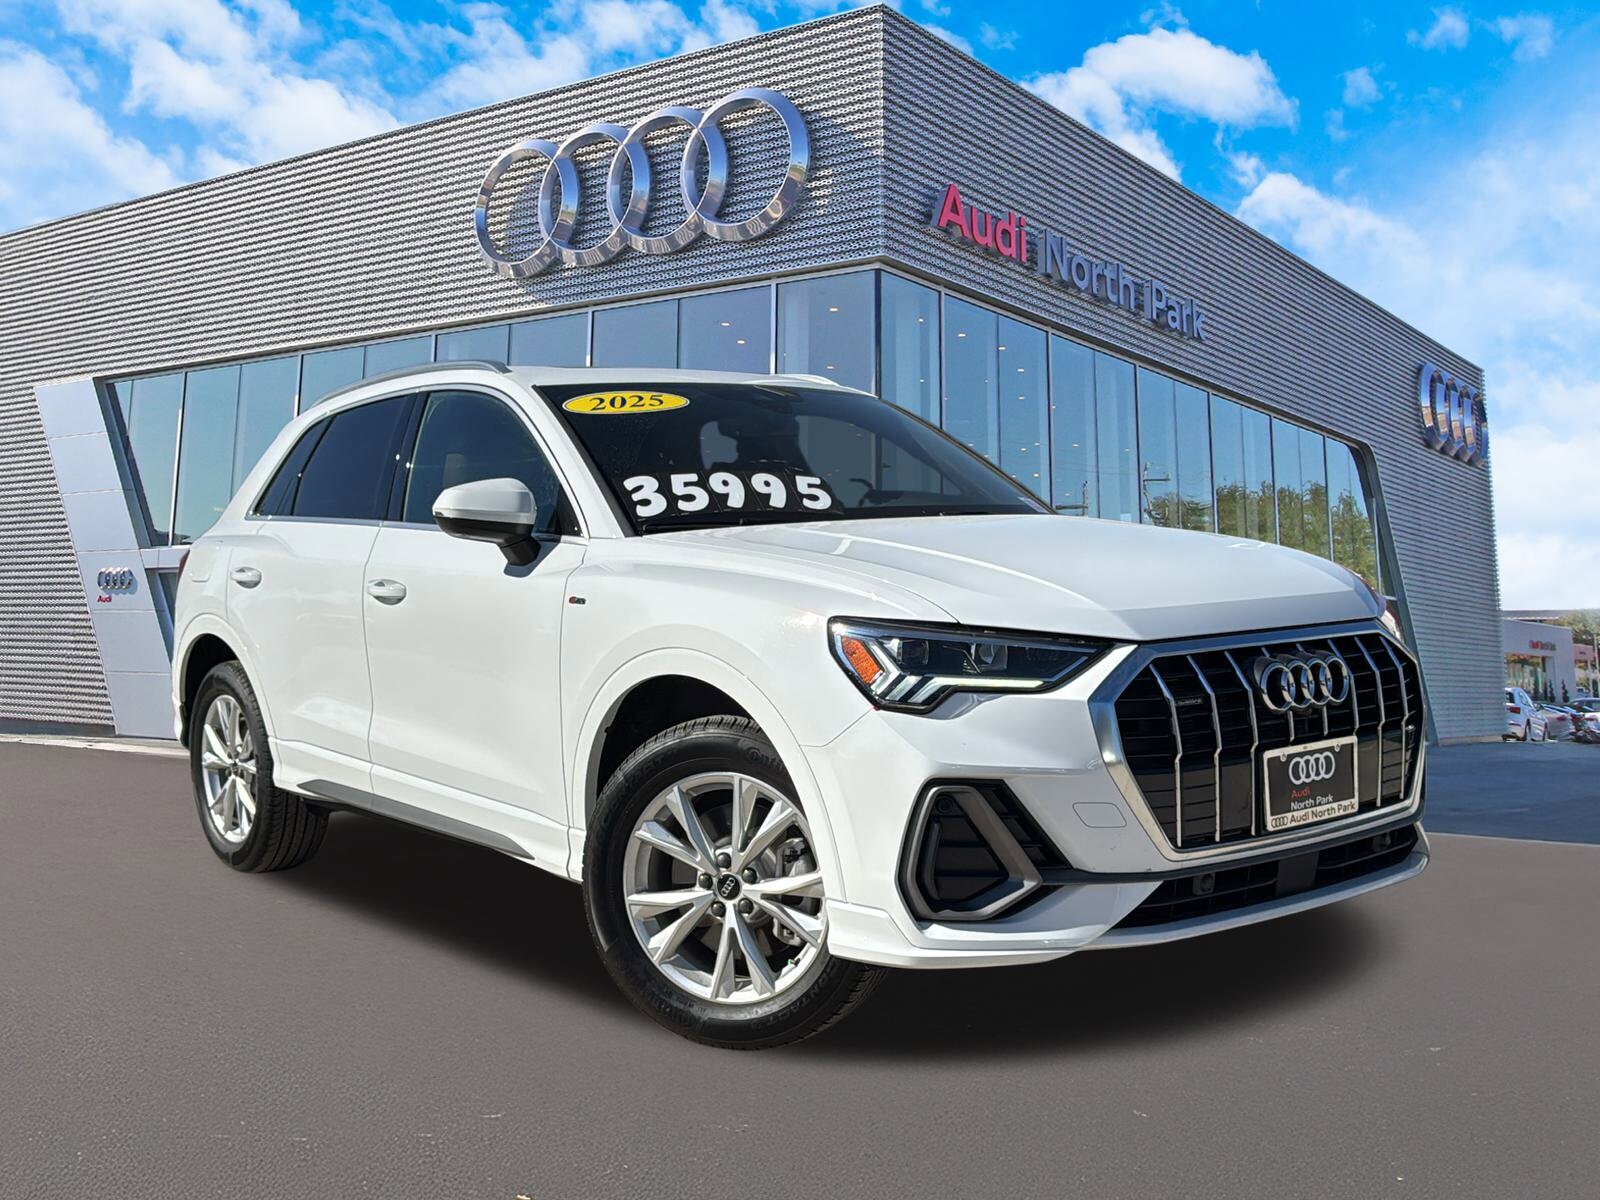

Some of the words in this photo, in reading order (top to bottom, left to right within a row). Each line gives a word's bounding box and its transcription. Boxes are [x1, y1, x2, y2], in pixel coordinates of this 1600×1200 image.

[933, 183, 1028, 263] Audi
[1038, 230, 1136, 311] North
[1144, 278, 1206, 340] Park
[589, 393, 665, 411] 2025
[623, 471, 832, 518] 35995
[1291, 785, 1311, 798] Audi
[1290, 798, 1315, 811] North
[1316, 794, 1333, 806] Park
[1289, 812, 1310, 825] Audi
[1311, 807, 1336, 820] North
[1337, 802, 1356, 813] Park
